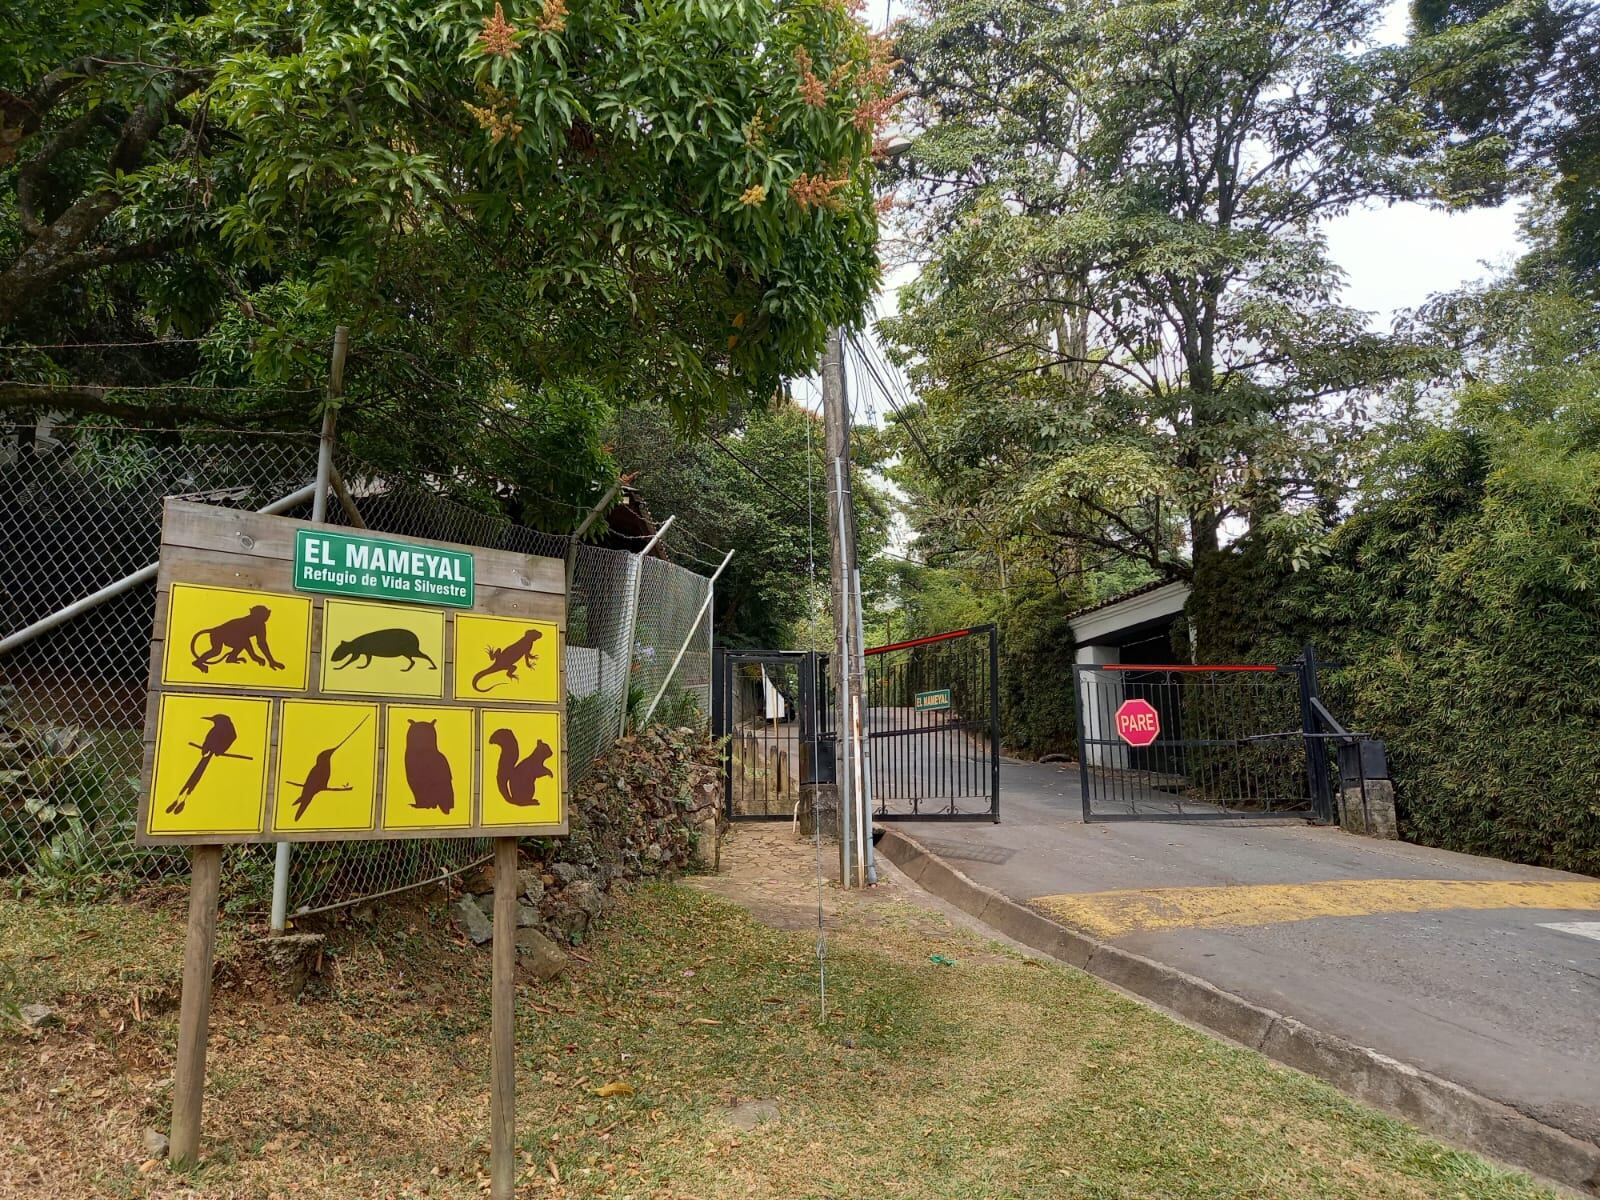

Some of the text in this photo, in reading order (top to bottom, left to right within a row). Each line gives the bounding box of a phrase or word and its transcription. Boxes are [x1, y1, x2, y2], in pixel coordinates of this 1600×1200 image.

[305, 538, 466, 582] EL MAMEYAL
[304, 566, 467, 598] Refugio de Vida Silvestre
[1120, 713, 1155, 733] PARE
